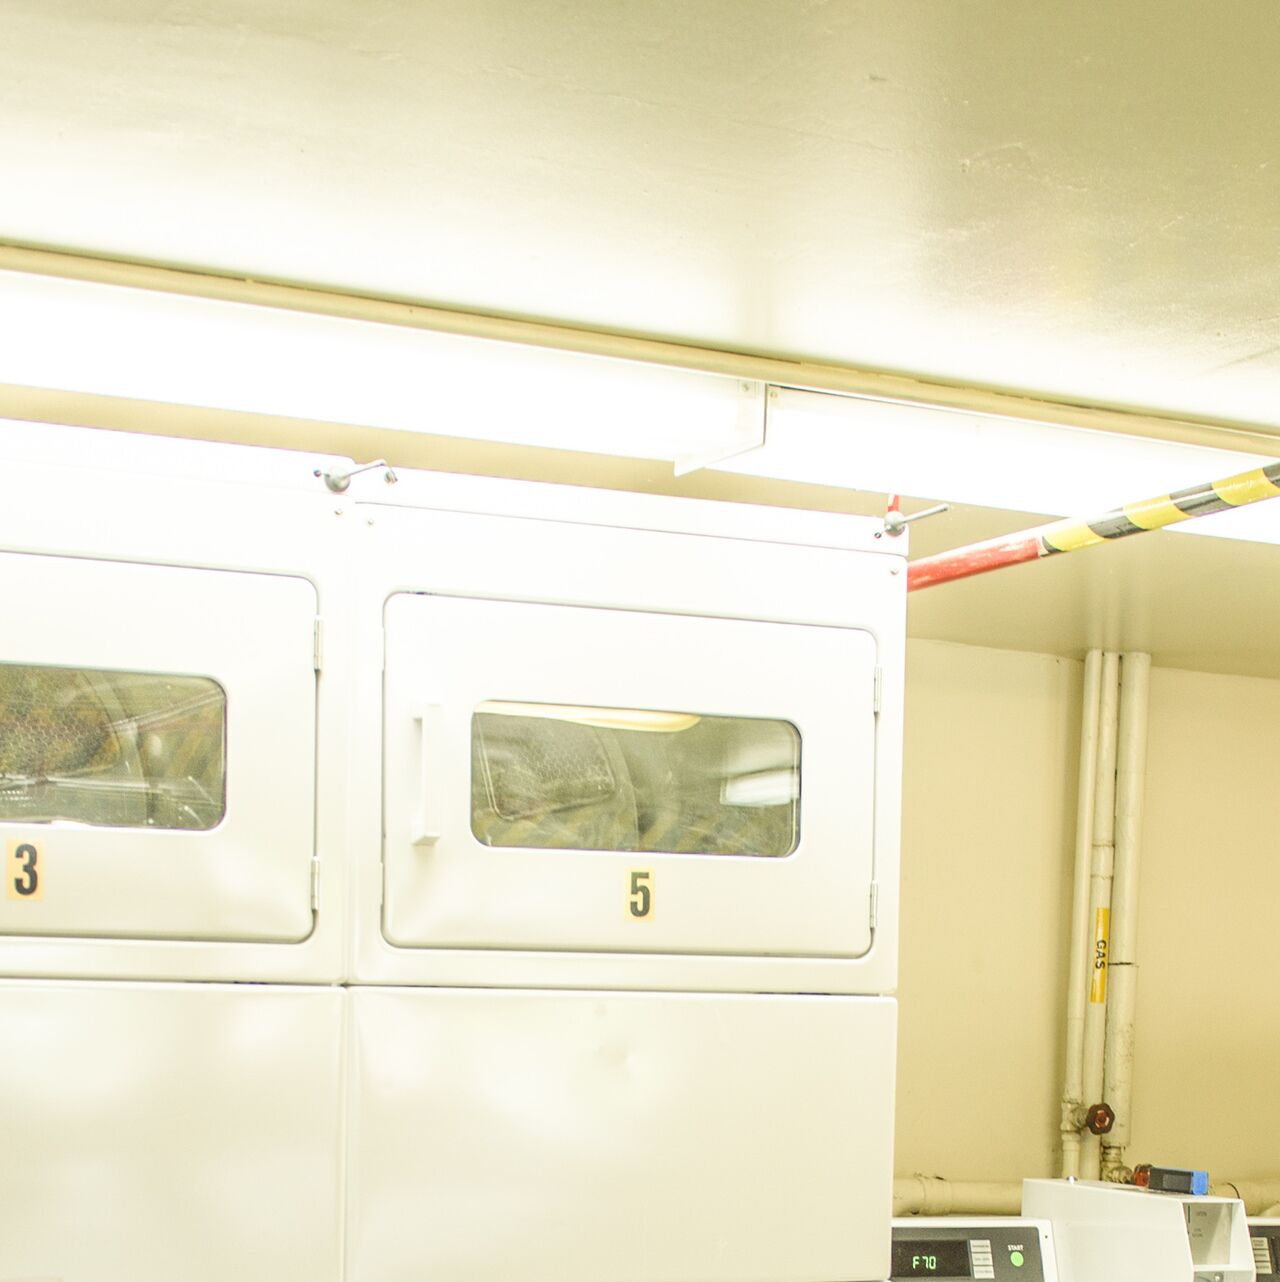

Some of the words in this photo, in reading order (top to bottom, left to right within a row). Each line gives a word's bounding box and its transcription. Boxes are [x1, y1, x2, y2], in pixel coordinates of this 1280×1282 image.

[15, 843, 38, 896] 3
[630, 872, 650, 917] 5
[1095, 939, 1107, 970] GAS
